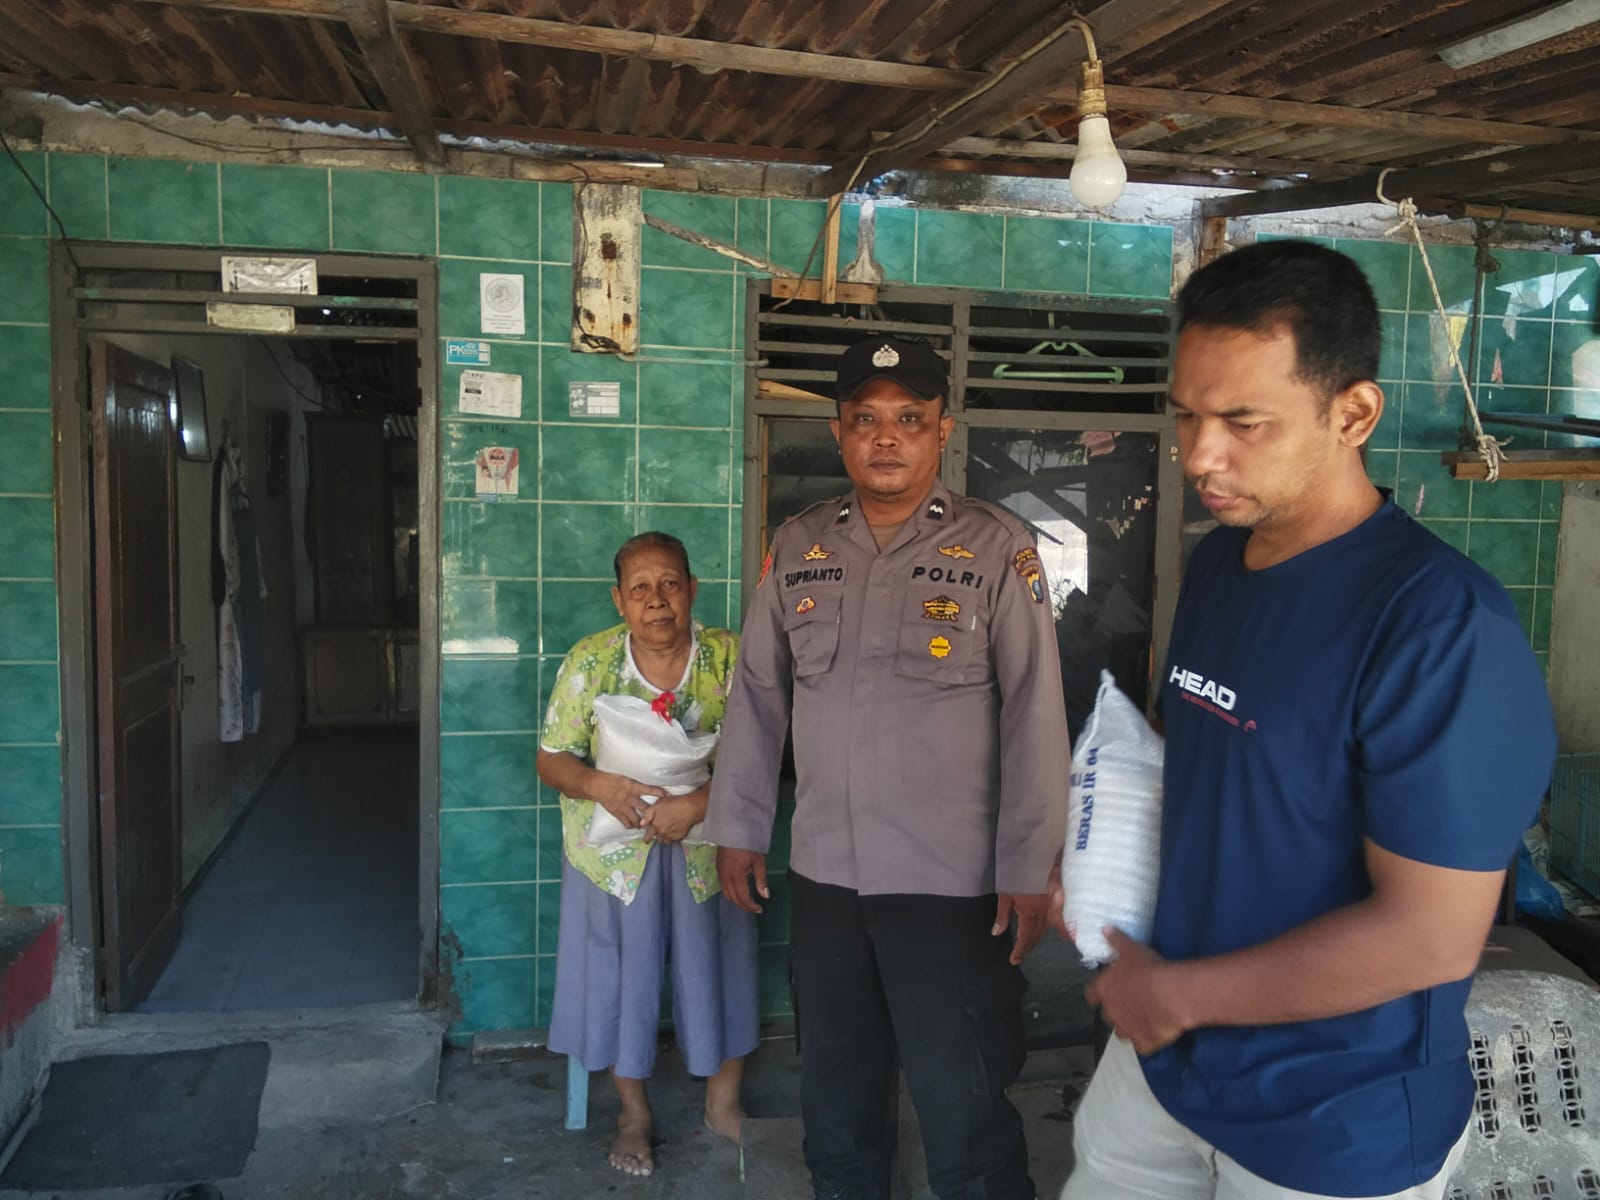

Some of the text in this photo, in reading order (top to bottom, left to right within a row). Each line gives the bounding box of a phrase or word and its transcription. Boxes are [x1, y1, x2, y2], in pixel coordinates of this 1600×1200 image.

[784, 567, 843, 587] SUPRIANTO
[911, 566, 983, 589] POLRI
[1169, 665, 1236, 710] HEAD
[1082, 771, 1096, 789] IR
[1075, 794, 1094, 851] BERAS
